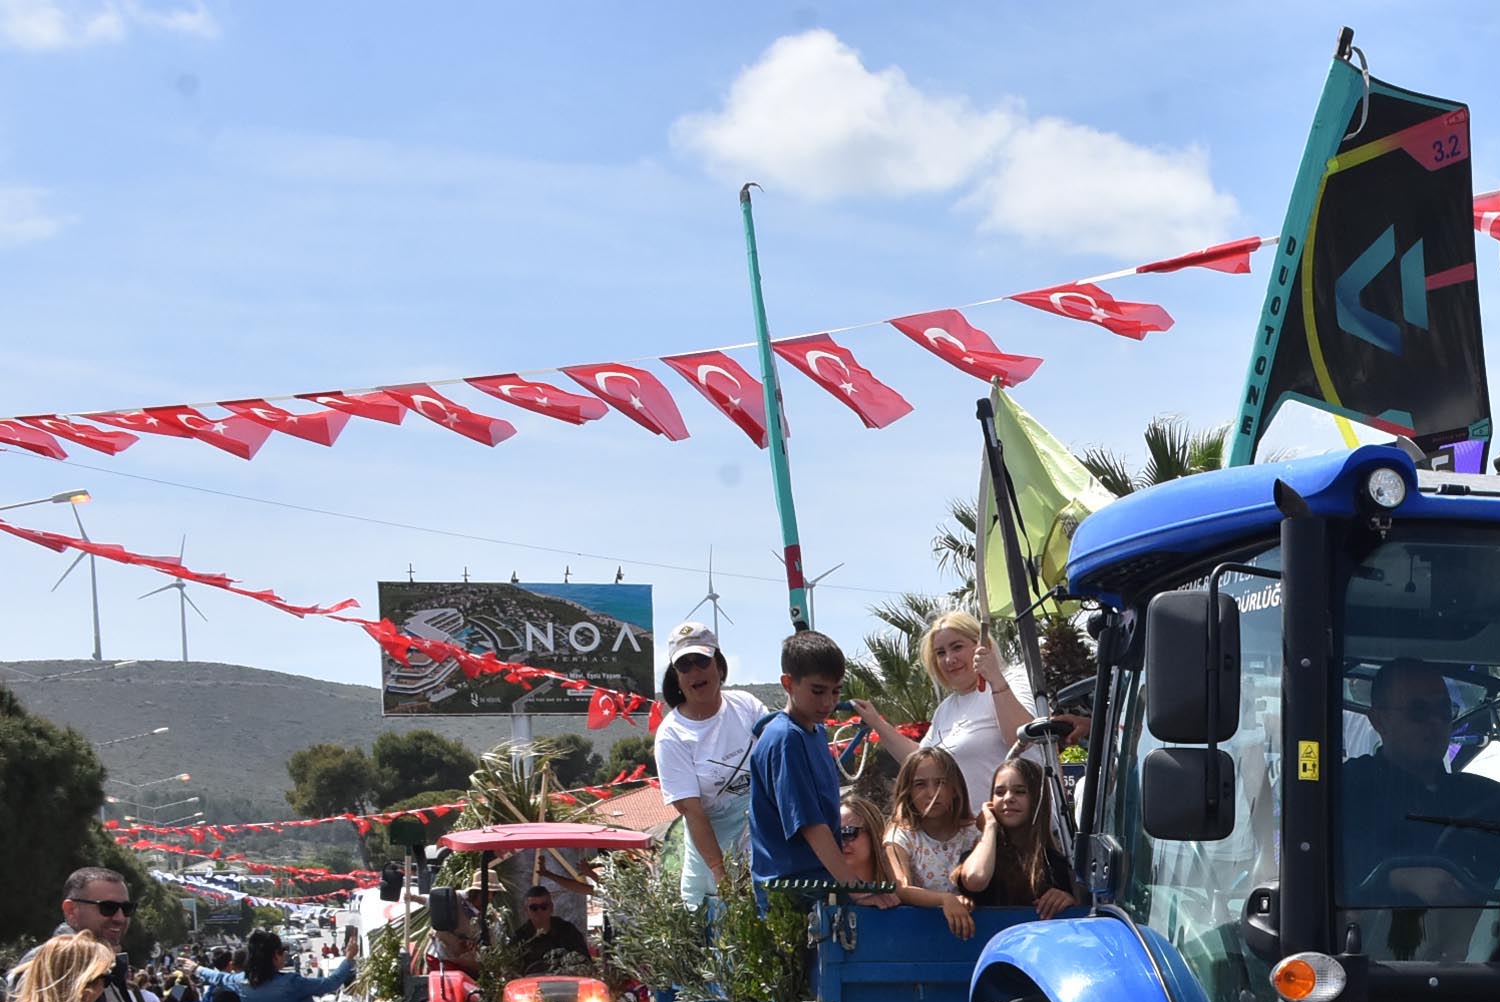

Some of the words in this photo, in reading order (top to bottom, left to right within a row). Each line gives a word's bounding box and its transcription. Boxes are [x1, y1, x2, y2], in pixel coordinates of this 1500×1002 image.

[1433, 136, 1461, 162] 3.2
[1238, 235, 1295, 437] DUOTONE
[1231, 582, 1282, 613] DÜRLÜĞ
[525, 621, 642, 652] NOA
